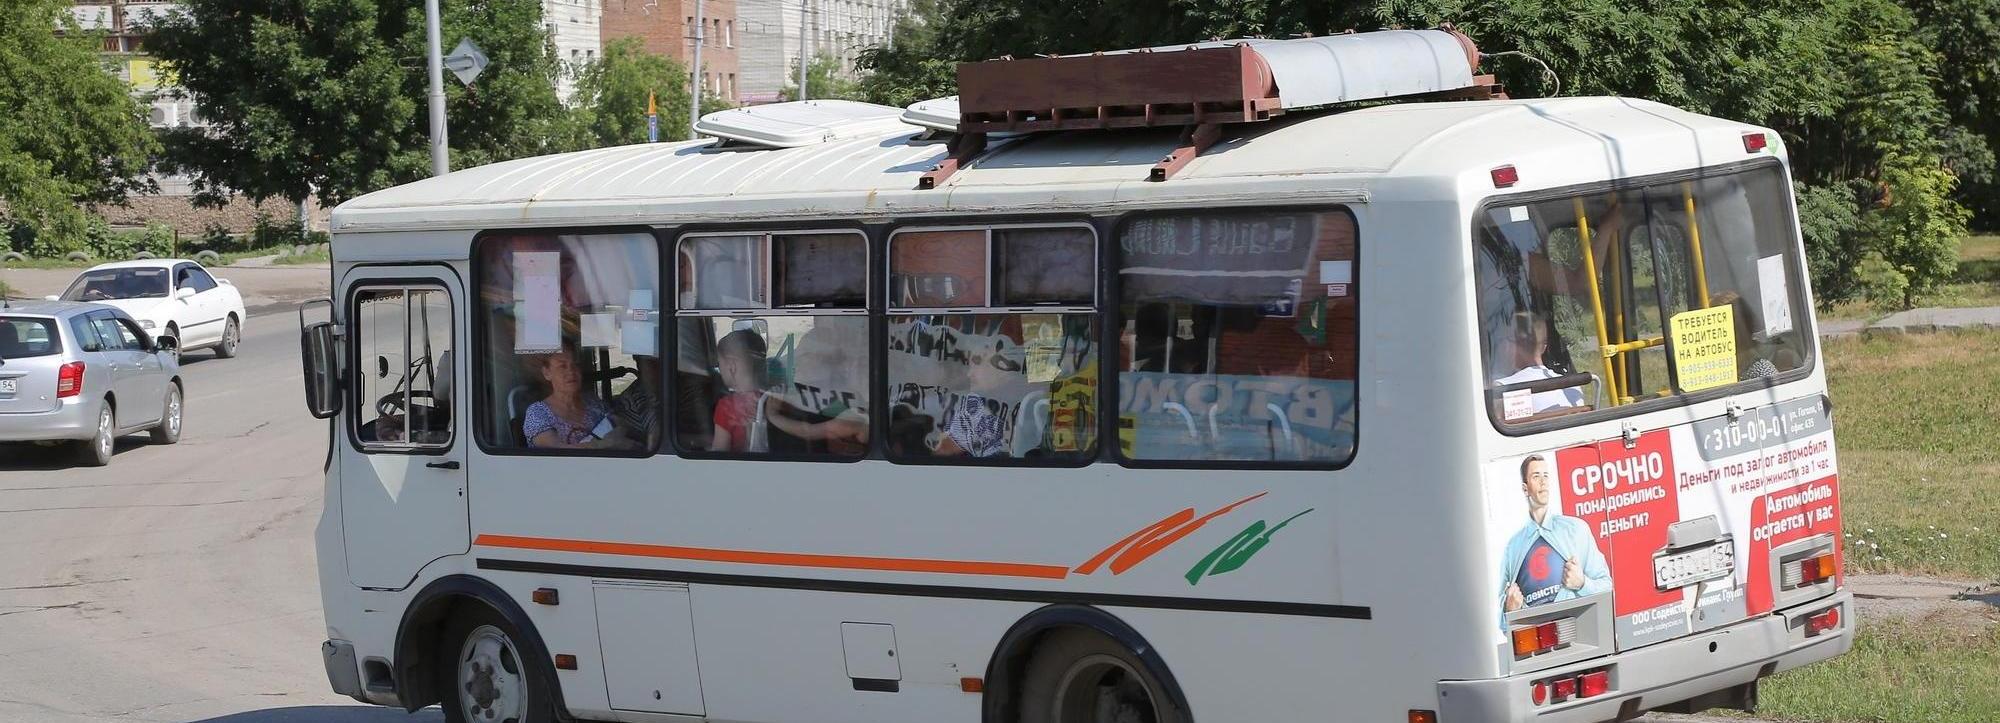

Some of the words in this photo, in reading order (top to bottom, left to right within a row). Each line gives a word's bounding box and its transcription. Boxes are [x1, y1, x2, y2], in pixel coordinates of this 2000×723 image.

[1678, 312, 1727, 329] ТРЕБУЕТСЯ
[1681, 327, 1728, 345] ВОДИТЕЛЬ
[1679, 349, 1692, 360] НА
[1695, 341, 1733, 358] АВТОБУС
[1571, 451, 1664, 496] СРОЧНО
[1679, 470, 1721, 492] Деньги
[1723, 462, 1745, 478] под
[1747, 455, 1774, 472] залог
[1777, 439, 1828, 465] автомобиля
[1731, 486, 1738, 494] и
[1739, 467, 1800, 491] недвижимости
[1801, 466, 1810, 475] за
[1817, 458, 1829, 470] час
[1575, 485, 1666, 517] ПОНАДОБИЛИСЬ
[1767, 484, 1832, 515] Автомобиль
[1599, 512, 1650, 538] ДЕНЬГИ?
[1753, 515, 1804, 542] остается
[1807, 510, 1814, 529] у
[1816, 504, 1834, 521] вас
[1631, 611, 1650, 626] ООО
